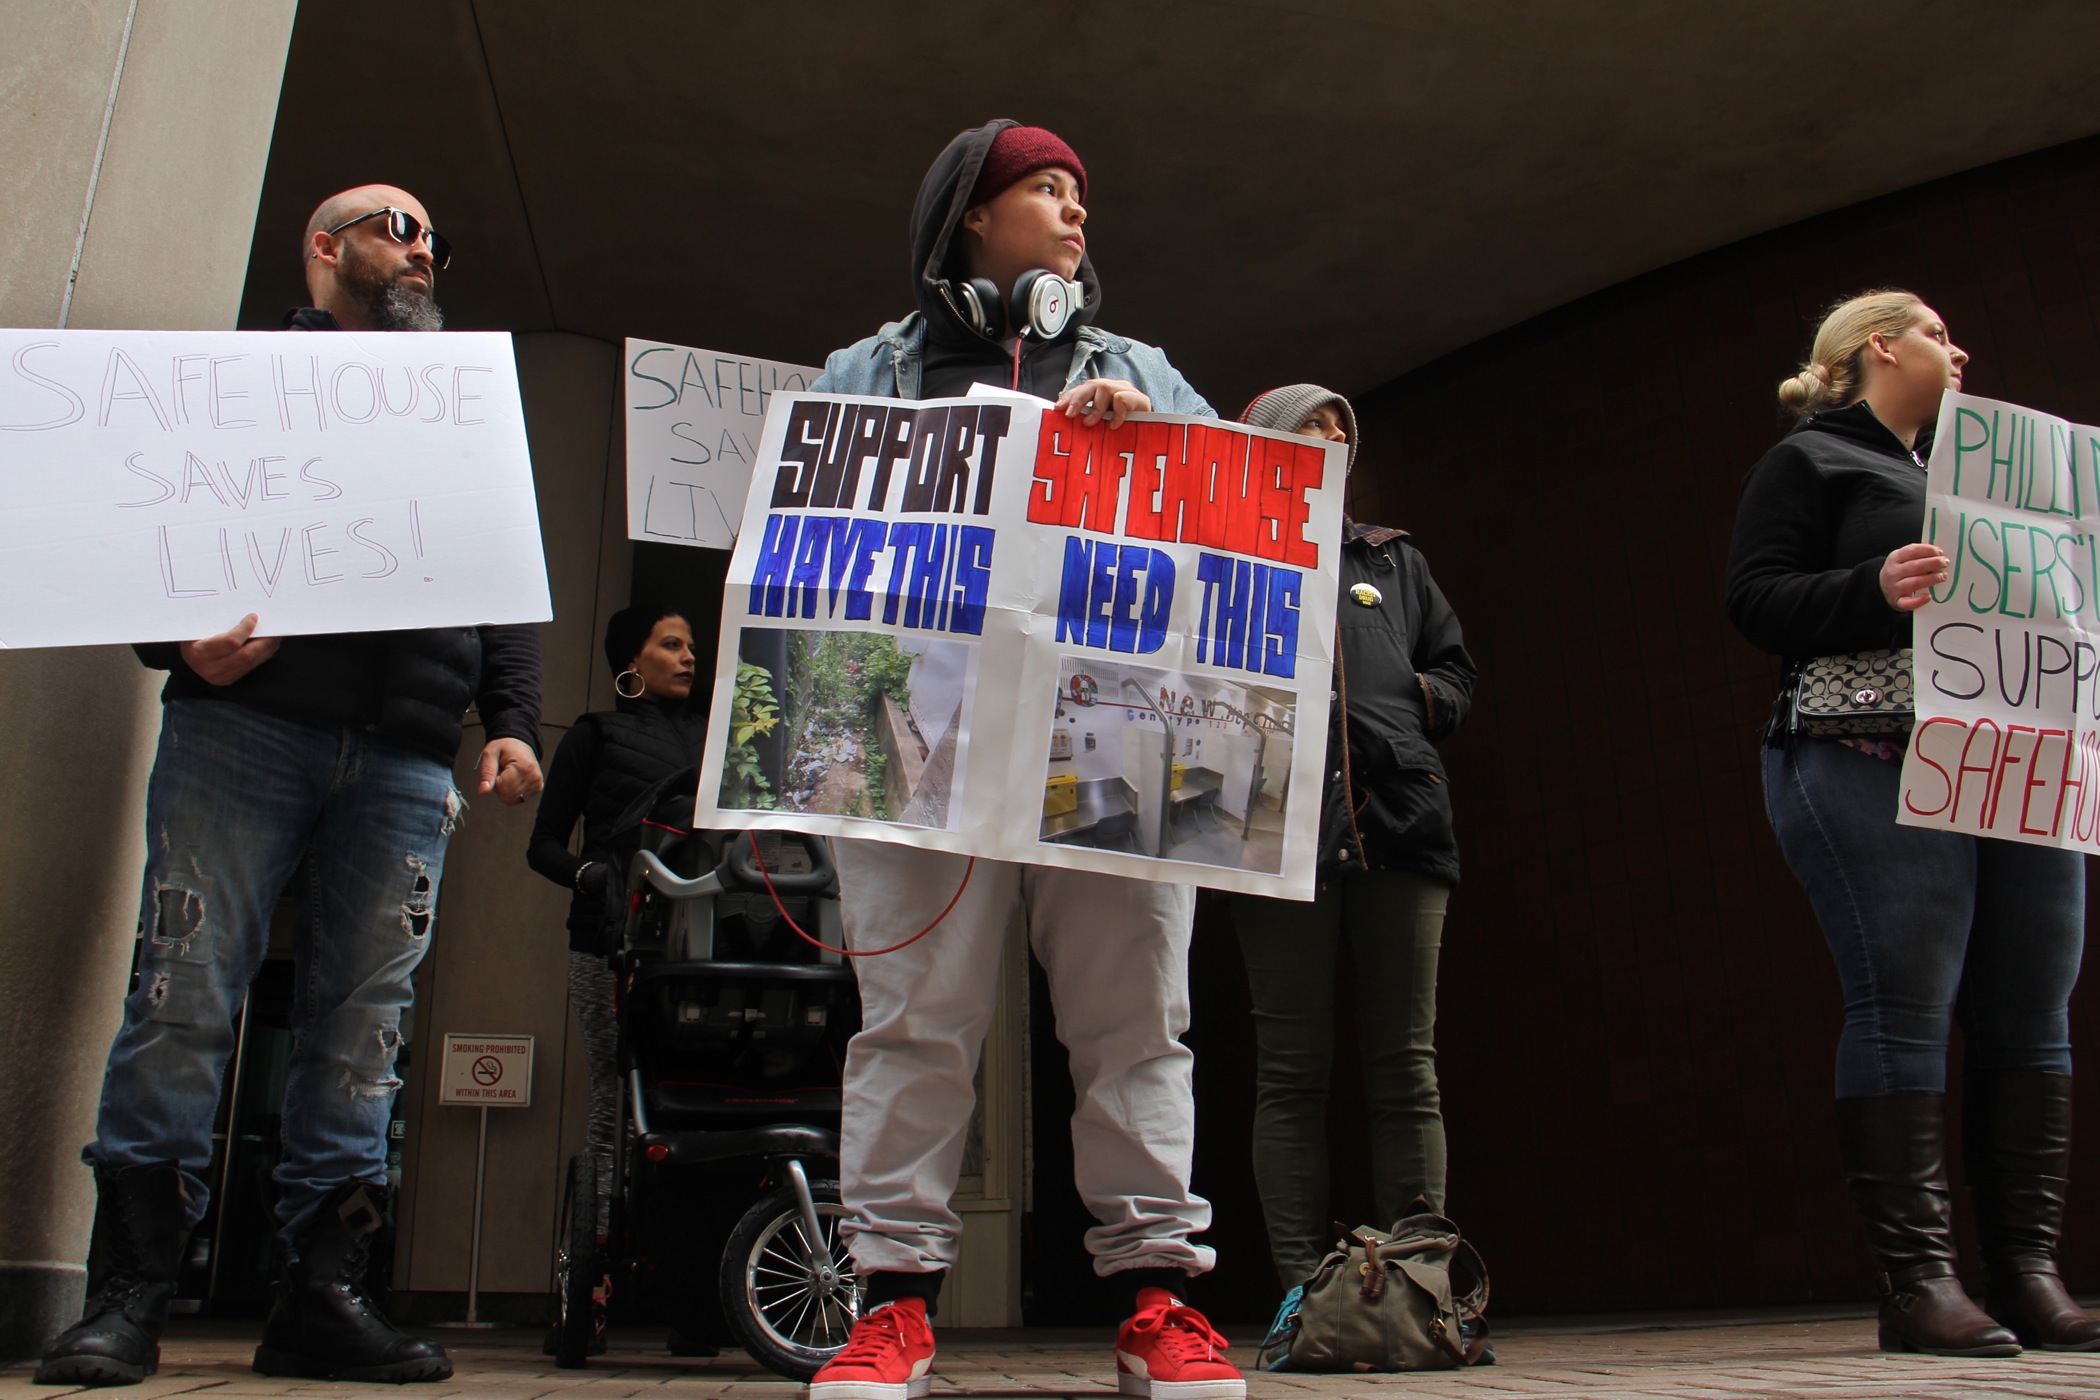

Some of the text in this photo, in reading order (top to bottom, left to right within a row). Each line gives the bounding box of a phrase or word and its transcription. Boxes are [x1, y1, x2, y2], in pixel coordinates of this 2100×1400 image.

[631, 347, 813, 417] SAFEH
[115, 450, 343, 510] SAVES
[769, 400, 1326, 570] SUPPORT SAFEHOUSE
[1952, 406, 2081, 521] PHILLY
[157, 500, 435, 599] LIVES!
[747, 514, 997, 636] HAVE THIS
[1055, 535, 1303, 679] NEED THIS
[1930, 622, 2100, 720] SUPP
[1904, 717, 2100, 845] SAFEHO
[452, 1044, 526, 1055] SMOKING PROHIBITED
[455, 1088, 516, 1099] WITHIN THIS AREA
